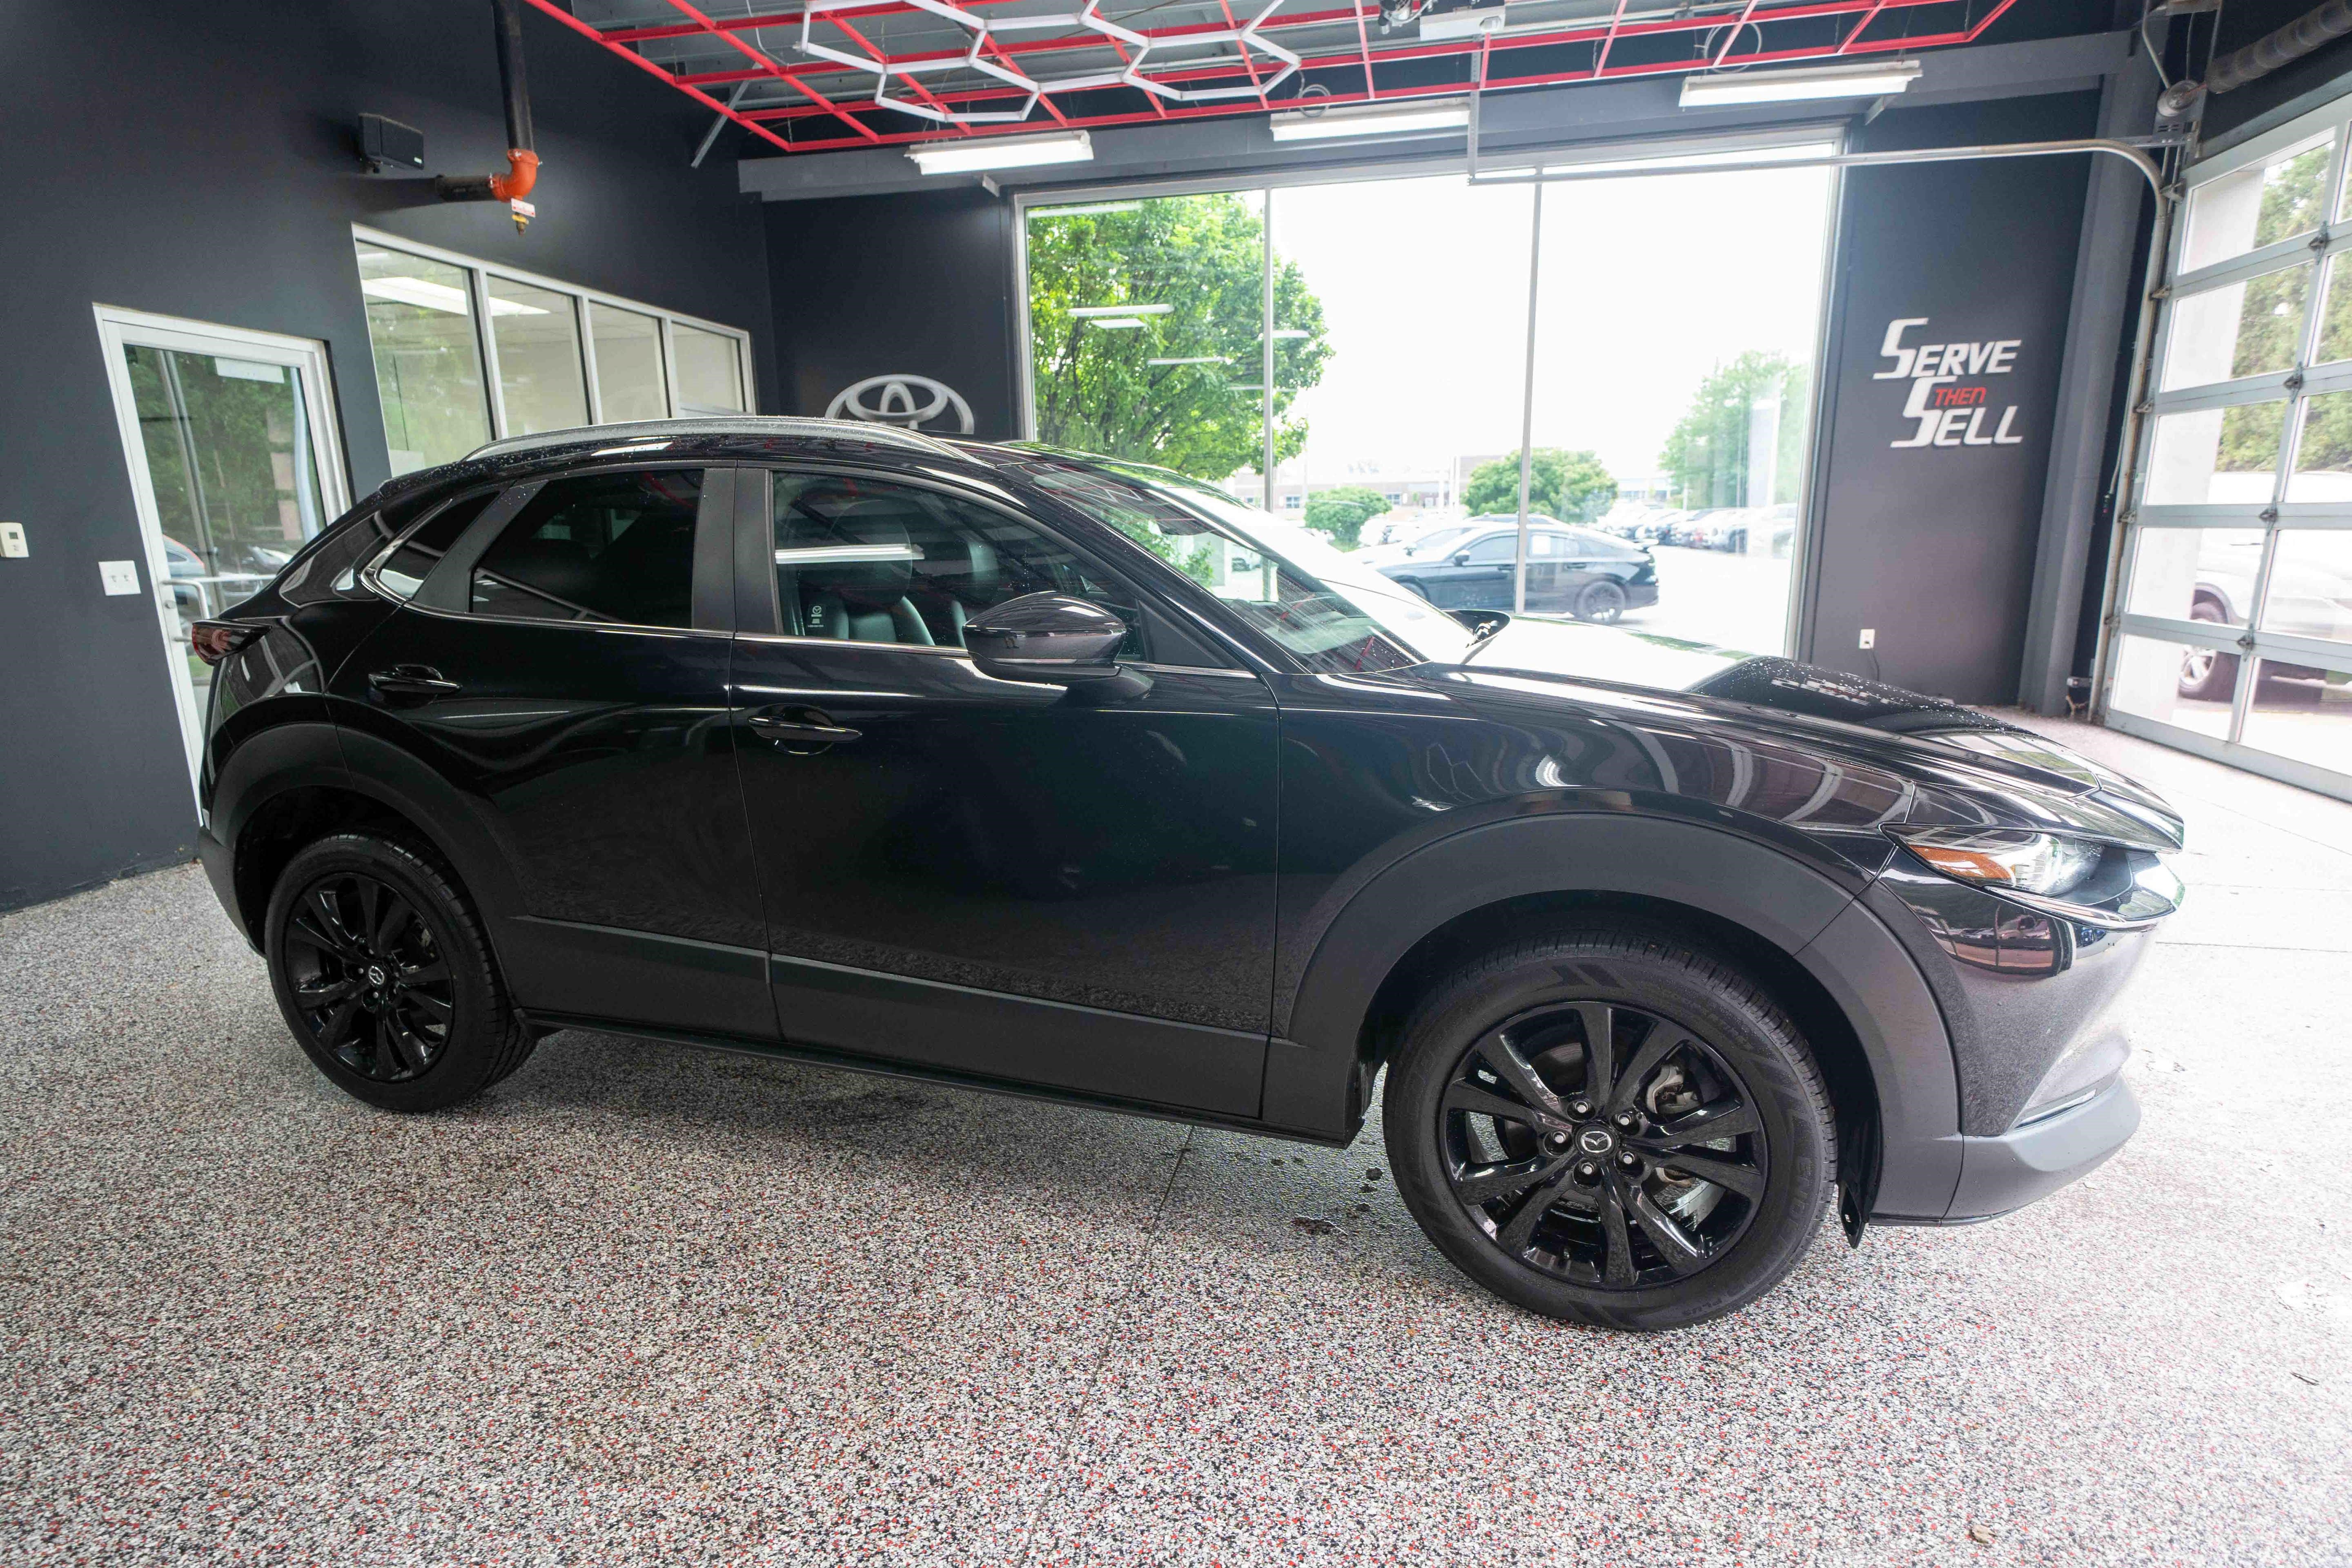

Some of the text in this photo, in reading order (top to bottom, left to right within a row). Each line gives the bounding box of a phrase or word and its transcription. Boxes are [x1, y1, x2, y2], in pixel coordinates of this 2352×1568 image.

[1873, 317, 2022, 379] SERVE
[1890, 375, 2023, 448] SELL
[1935, 387, 1987, 406] THEN
